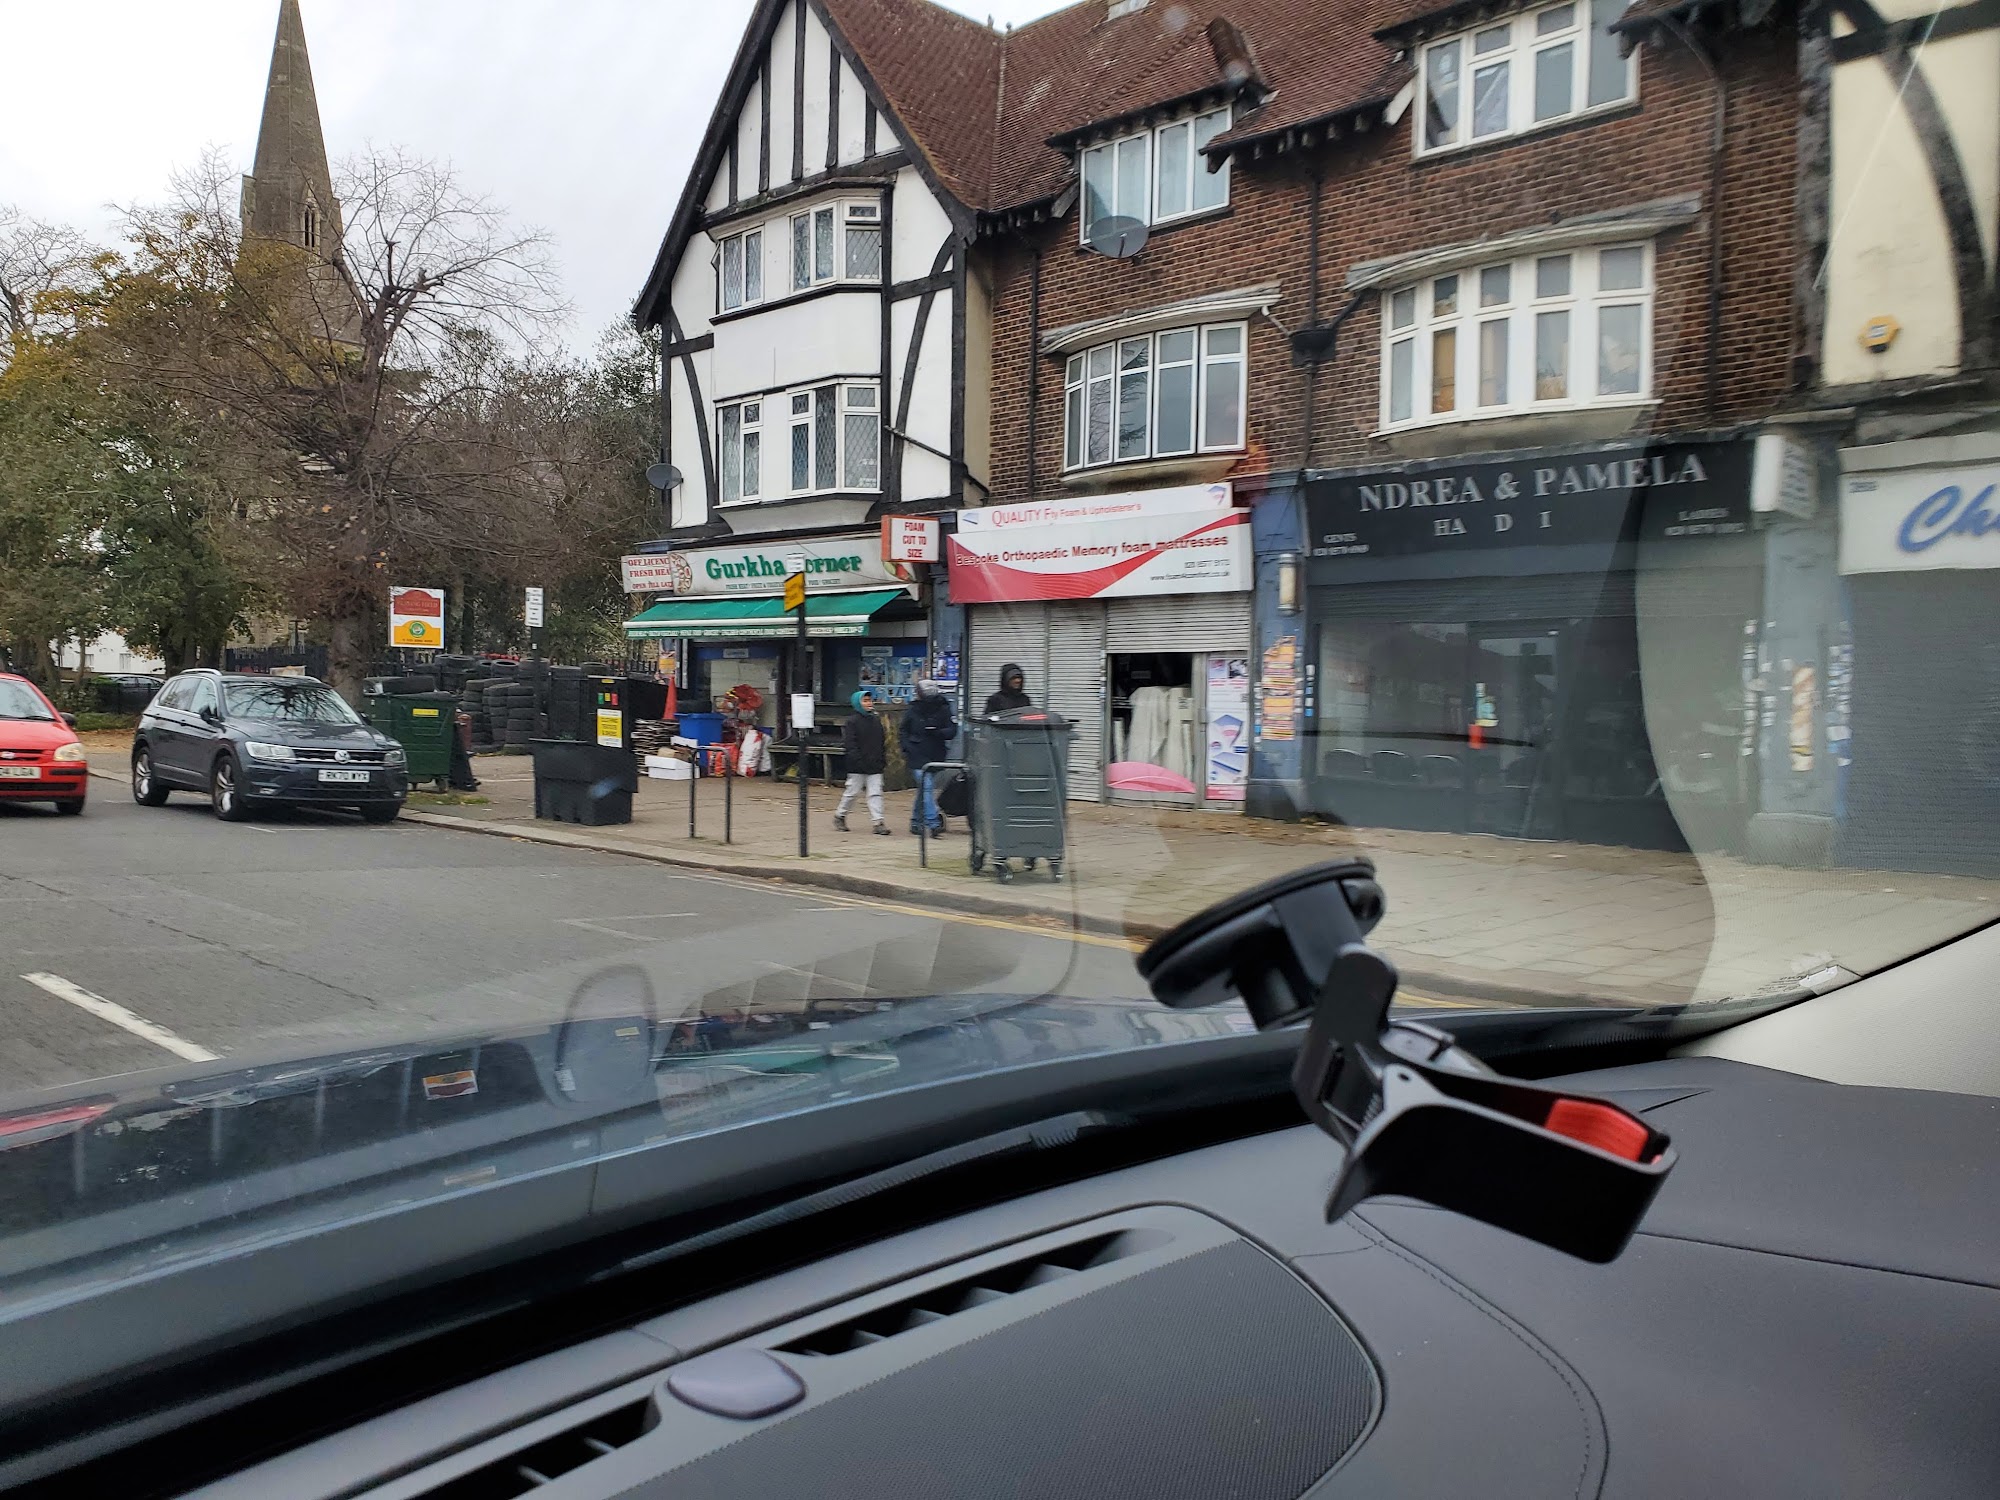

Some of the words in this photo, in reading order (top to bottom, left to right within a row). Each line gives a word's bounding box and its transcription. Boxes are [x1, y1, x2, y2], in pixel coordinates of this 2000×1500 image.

[1359, 474, 1484, 513] NDREA
[1494, 472, 1519, 501] &
[1533, 452, 1708, 498] PAMELA
[904, 522, 925, 531] FOAM
[992, 508, 1041, 528] QUALITY
[1434, 518, 1467, 537] HA
[1495, 513, 1513, 533] D
[1540, 511, 1553, 530] I
[1897, 484, 2000, 553] Ch
[903, 535, 916, 544] CUT
[918, 536, 927, 545] TO
[956, 552, 999, 567] Bespoke
[1002, 546, 1068, 564] Orthopaedic
[1071, 544, 1117, 559] Memory
[1121, 540, 1151, 553] foam
[1156, 535, 1229, 551] mattresses
[907, 548, 923, 558] SIZE
[705, 555, 786, 579] Gurkha
[804, 555, 862, 574] orner
